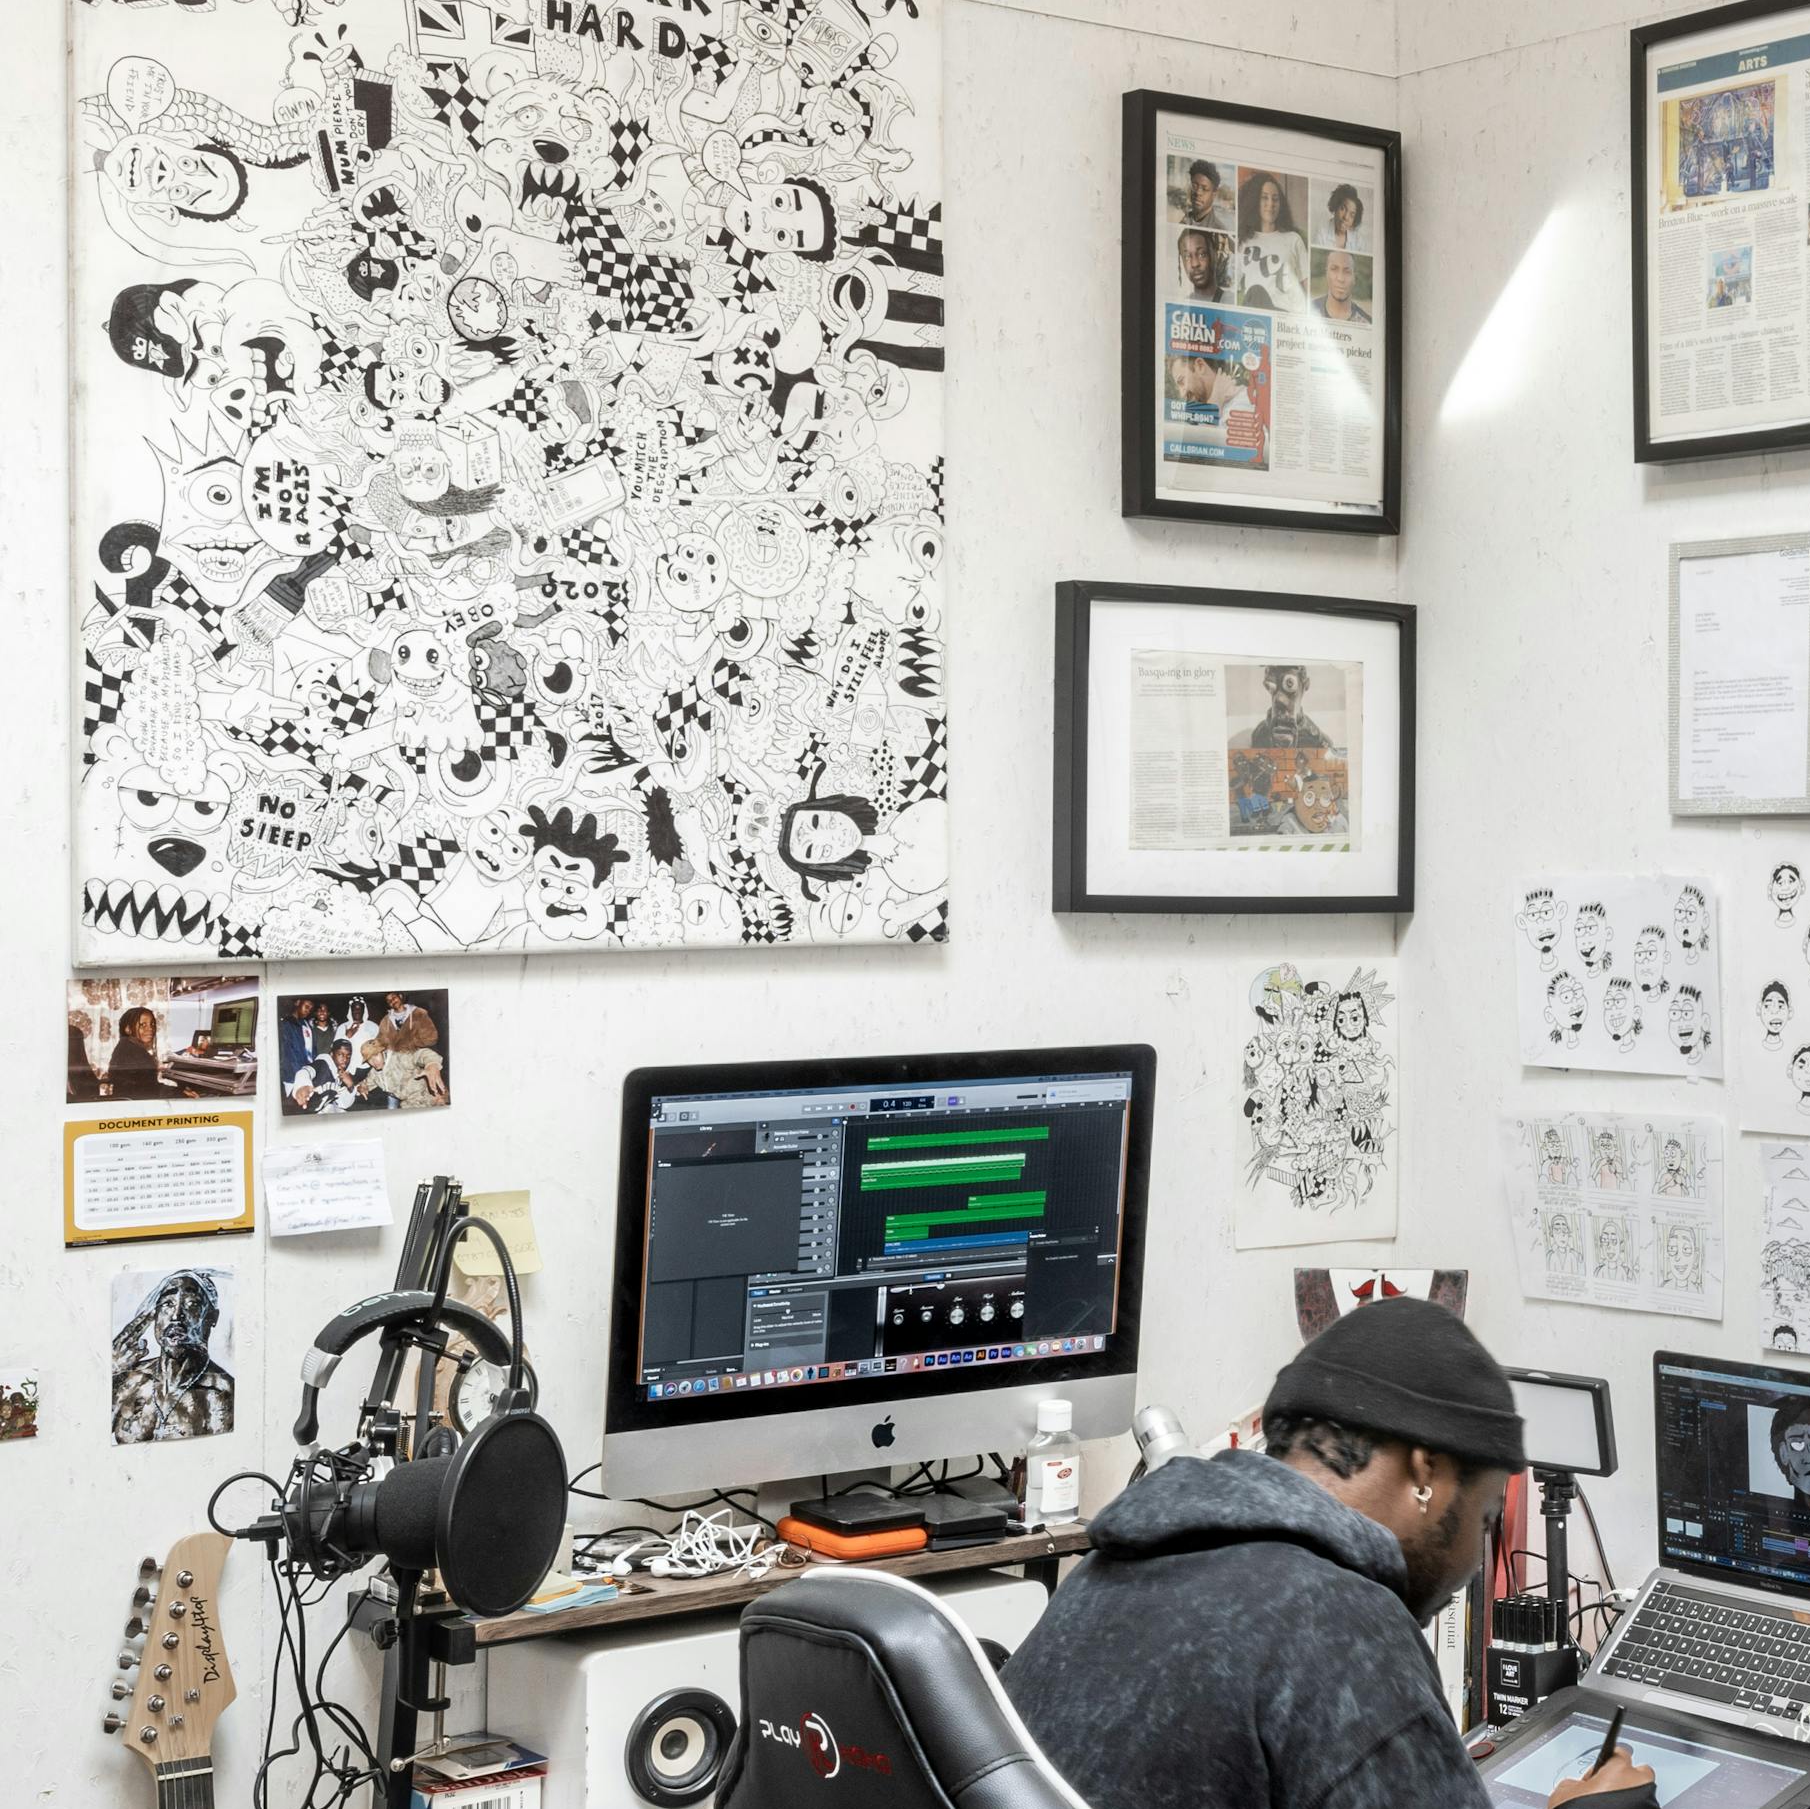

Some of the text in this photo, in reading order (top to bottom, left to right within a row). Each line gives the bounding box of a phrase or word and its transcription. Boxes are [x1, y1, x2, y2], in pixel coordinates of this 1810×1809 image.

[1738, 56, 1769, 72] ARTS
[335, 139, 356, 186] MUM
[1172, 311, 1206, 328] CALL
[1277, 321, 1300, 335] Black
[1171, 324, 1215, 344] BRIAN
[1276, 338, 1373, 360] project picked
[647, 455, 658, 483] THE
[653, 420, 667, 503] DESCRIPTION
[253, 466, 271, 519] I'M
[273, 461, 292, 523] NOT
[631, 471, 643, 500] YOU
[541, 579, 622, 602] 2020
[442, 603, 494, 634] OBEY
[874, 628, 890, 669] ALONE
[825, 680, 842, 710] WHY
[842, 655, 855, 674] DO
[1183, 668, 1192, 678] in
[1193, 666, 1216, 680] glory
[590, 693, 604, 735] 2017
[258, 794, 296, 820] NO
[99, 1115, 220, 1131] DOCUMENT PRINTING
[925, 1355, 935, 1365] Ps
[938, 1354, 948, 1364] Au
[951, 1352, 961, 1362] An
[976, 1348, 986, 1359] Ai
[989, 1348, 999, 1358] Pr
[1493, 1692, 1529, 1706] TWIN MARKER
[1499, 1703, 1508, 1715] 12
